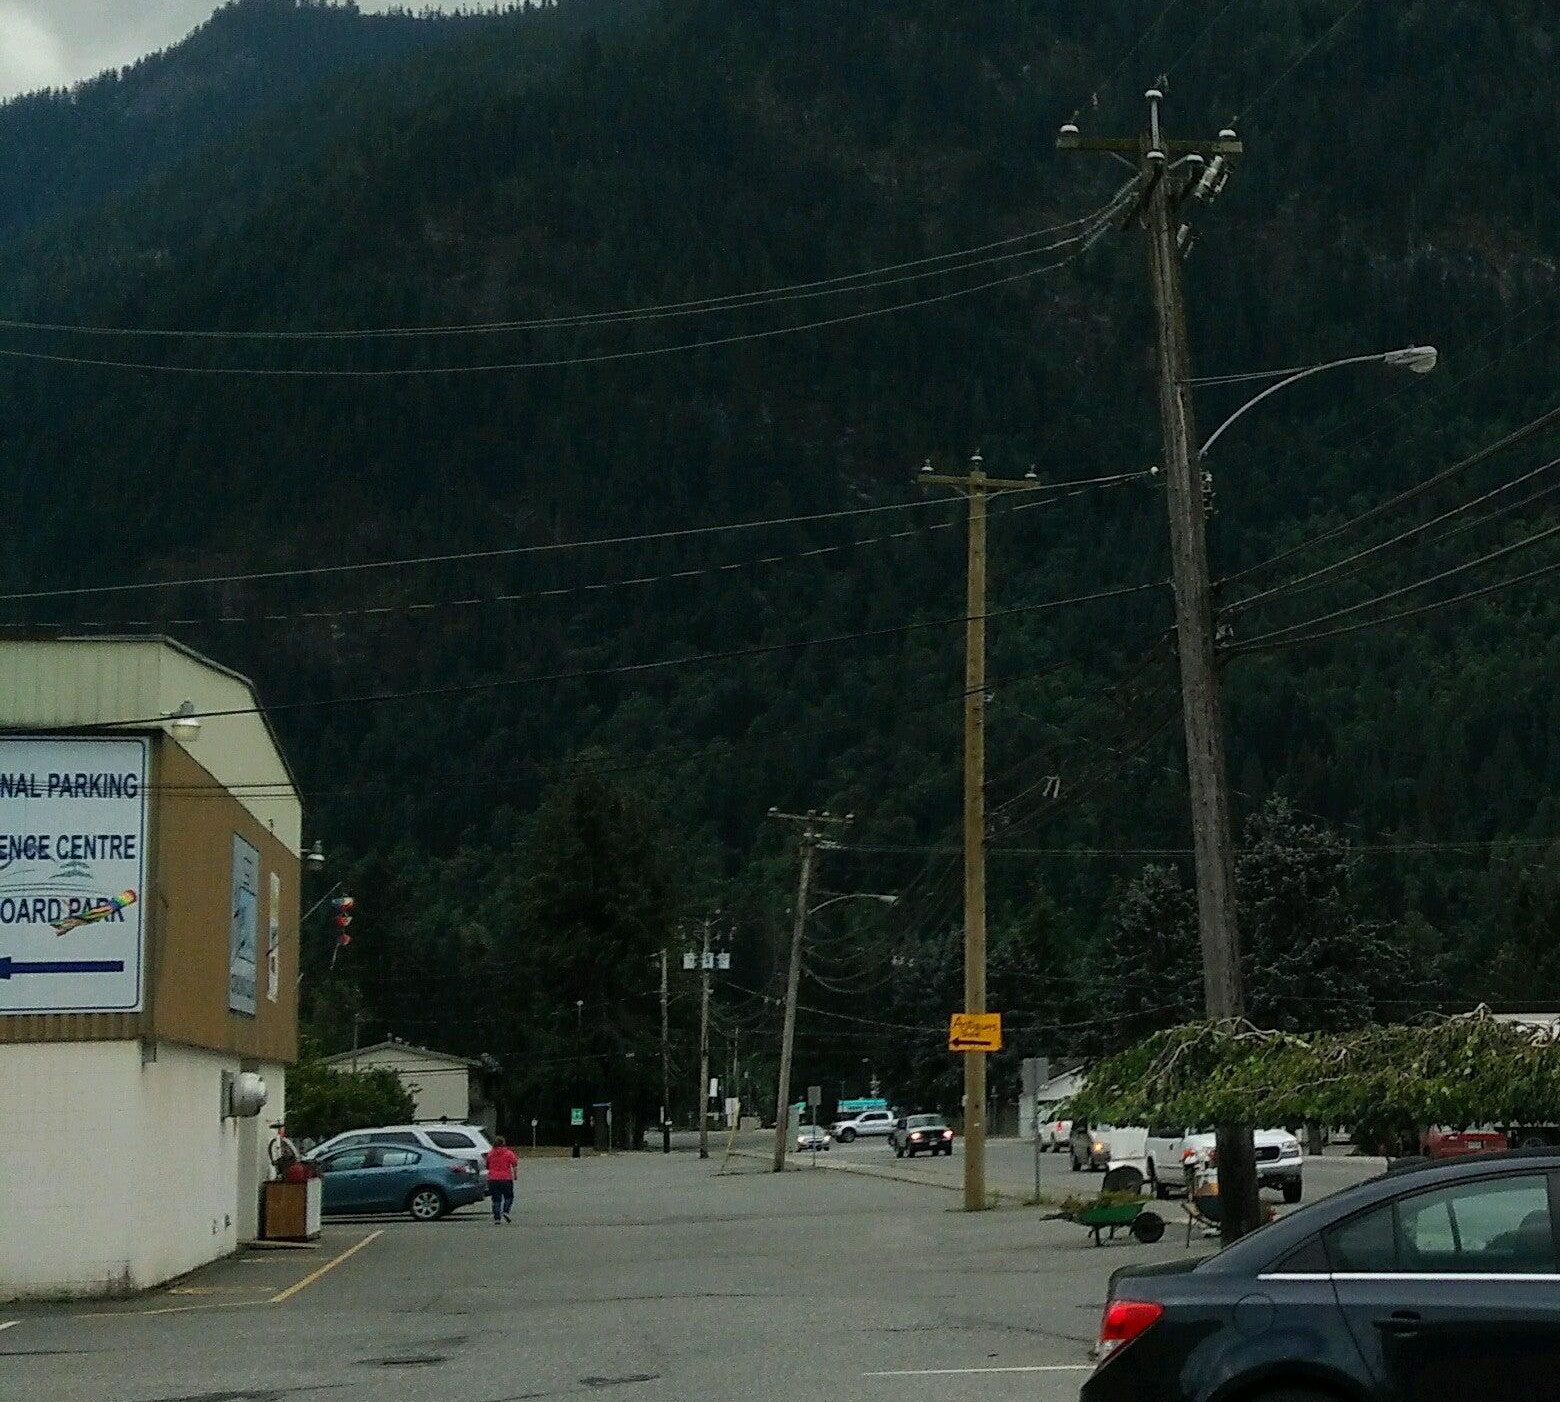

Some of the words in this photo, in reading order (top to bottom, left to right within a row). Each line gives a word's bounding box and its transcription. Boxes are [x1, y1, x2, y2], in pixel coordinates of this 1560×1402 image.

[0, 773, 41, 798] NAL
[48, 773, 138, 799] PARKING
[56, 834, 136, 859] CENTRE
[0, 897, 61, 923] OARD
